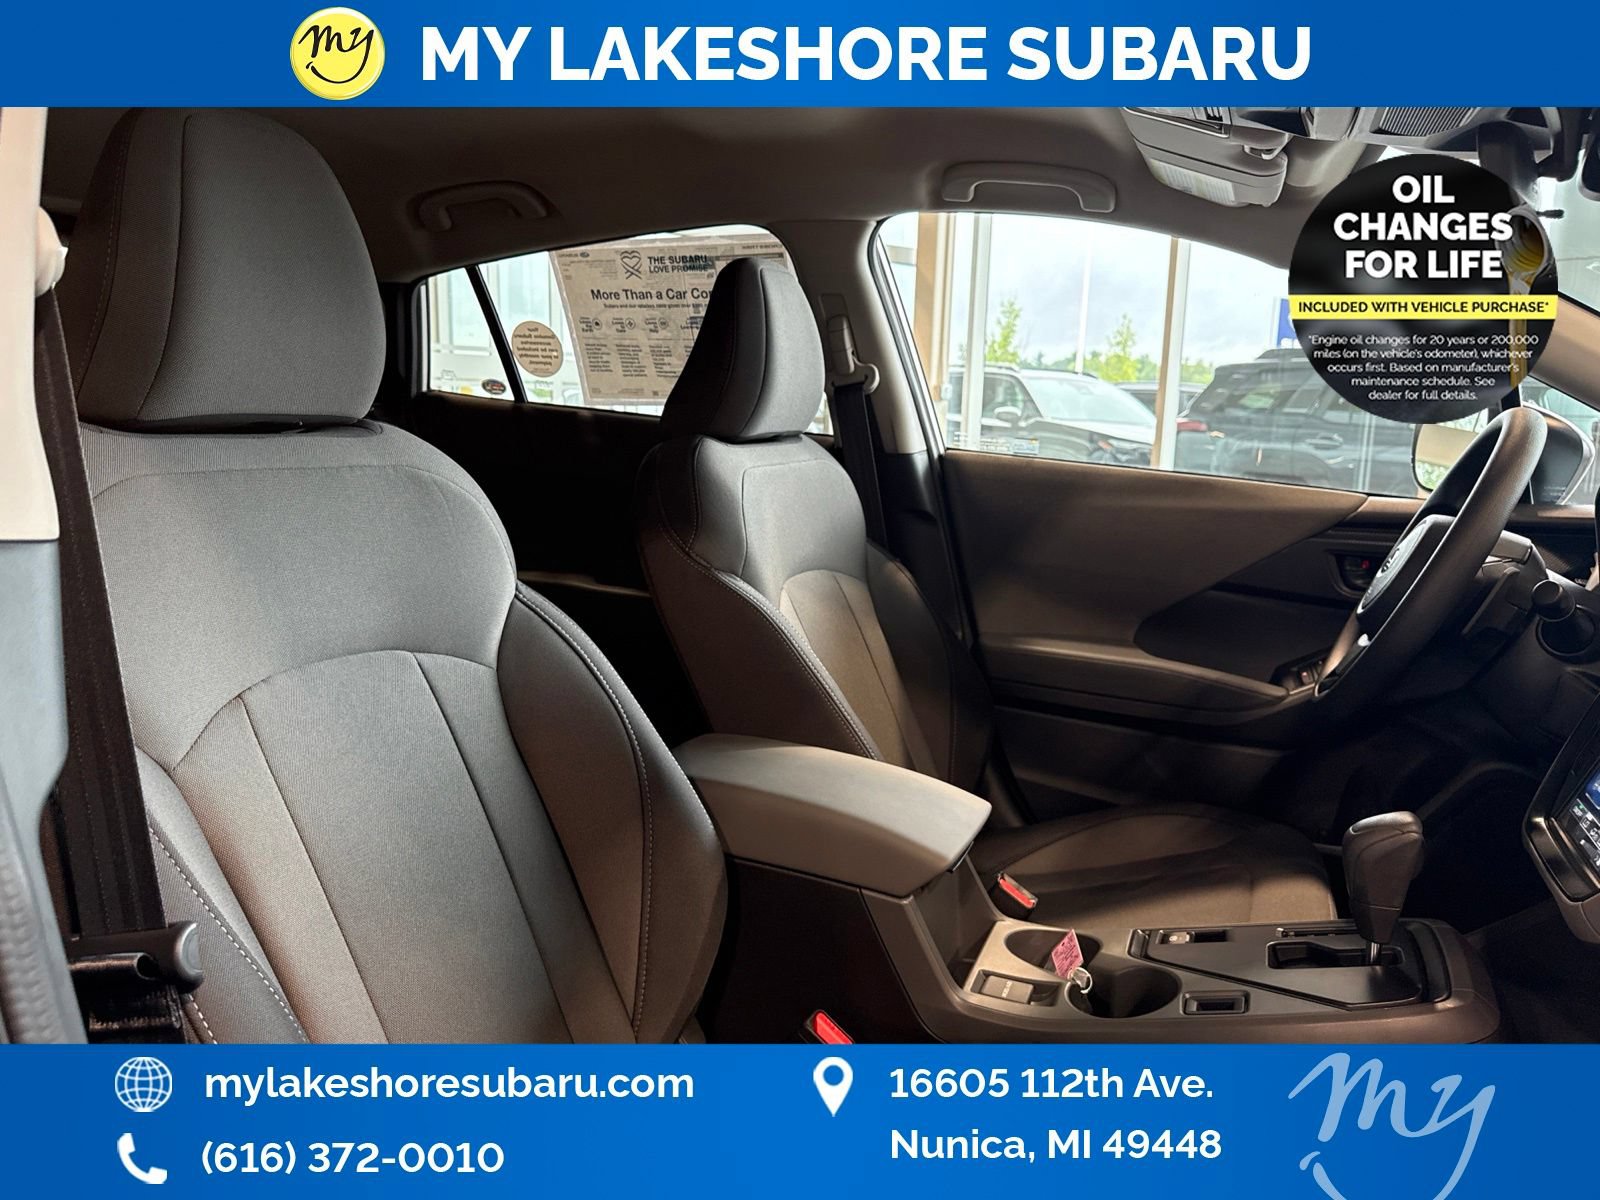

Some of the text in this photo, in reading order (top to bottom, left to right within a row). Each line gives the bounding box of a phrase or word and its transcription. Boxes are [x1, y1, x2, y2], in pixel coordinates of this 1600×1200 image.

[648, 255, 707, 265] THE SUBARU
[648, 264, 708, 274] LOVE PROMISE
[590, 289, 620, 301] More
[622, 288, 652, 300] Than
[655, 291, 663, 300] a
[665, 288, 687, 300] Car
